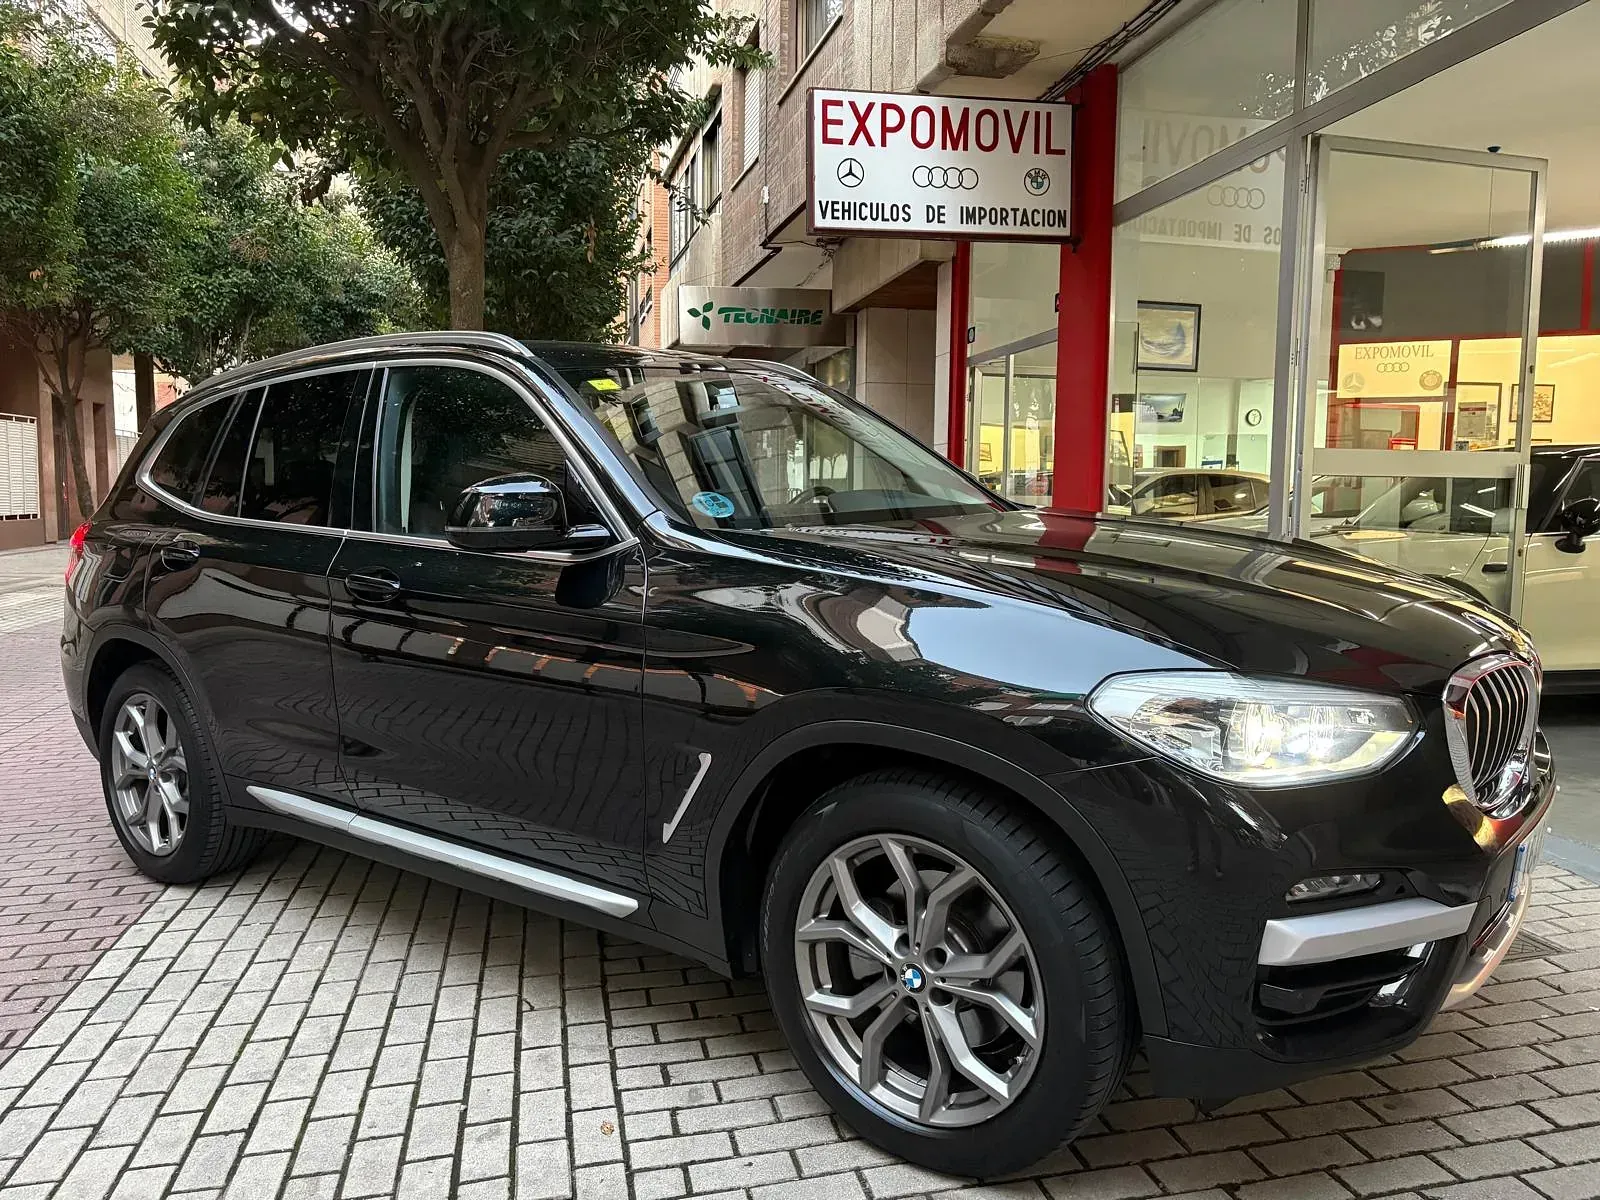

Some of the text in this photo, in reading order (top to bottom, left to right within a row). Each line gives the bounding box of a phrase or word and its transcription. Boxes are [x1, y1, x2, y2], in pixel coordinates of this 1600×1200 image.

[821, 99, 1066, 156] EXPOMOVIL
[818, 200, 1067, 229] VEHICULOS DE IMPORTACION
[717, 307, 824, 325] TECNAIRE
[1355, 344, 1434, 360] EXPOMOVIL
